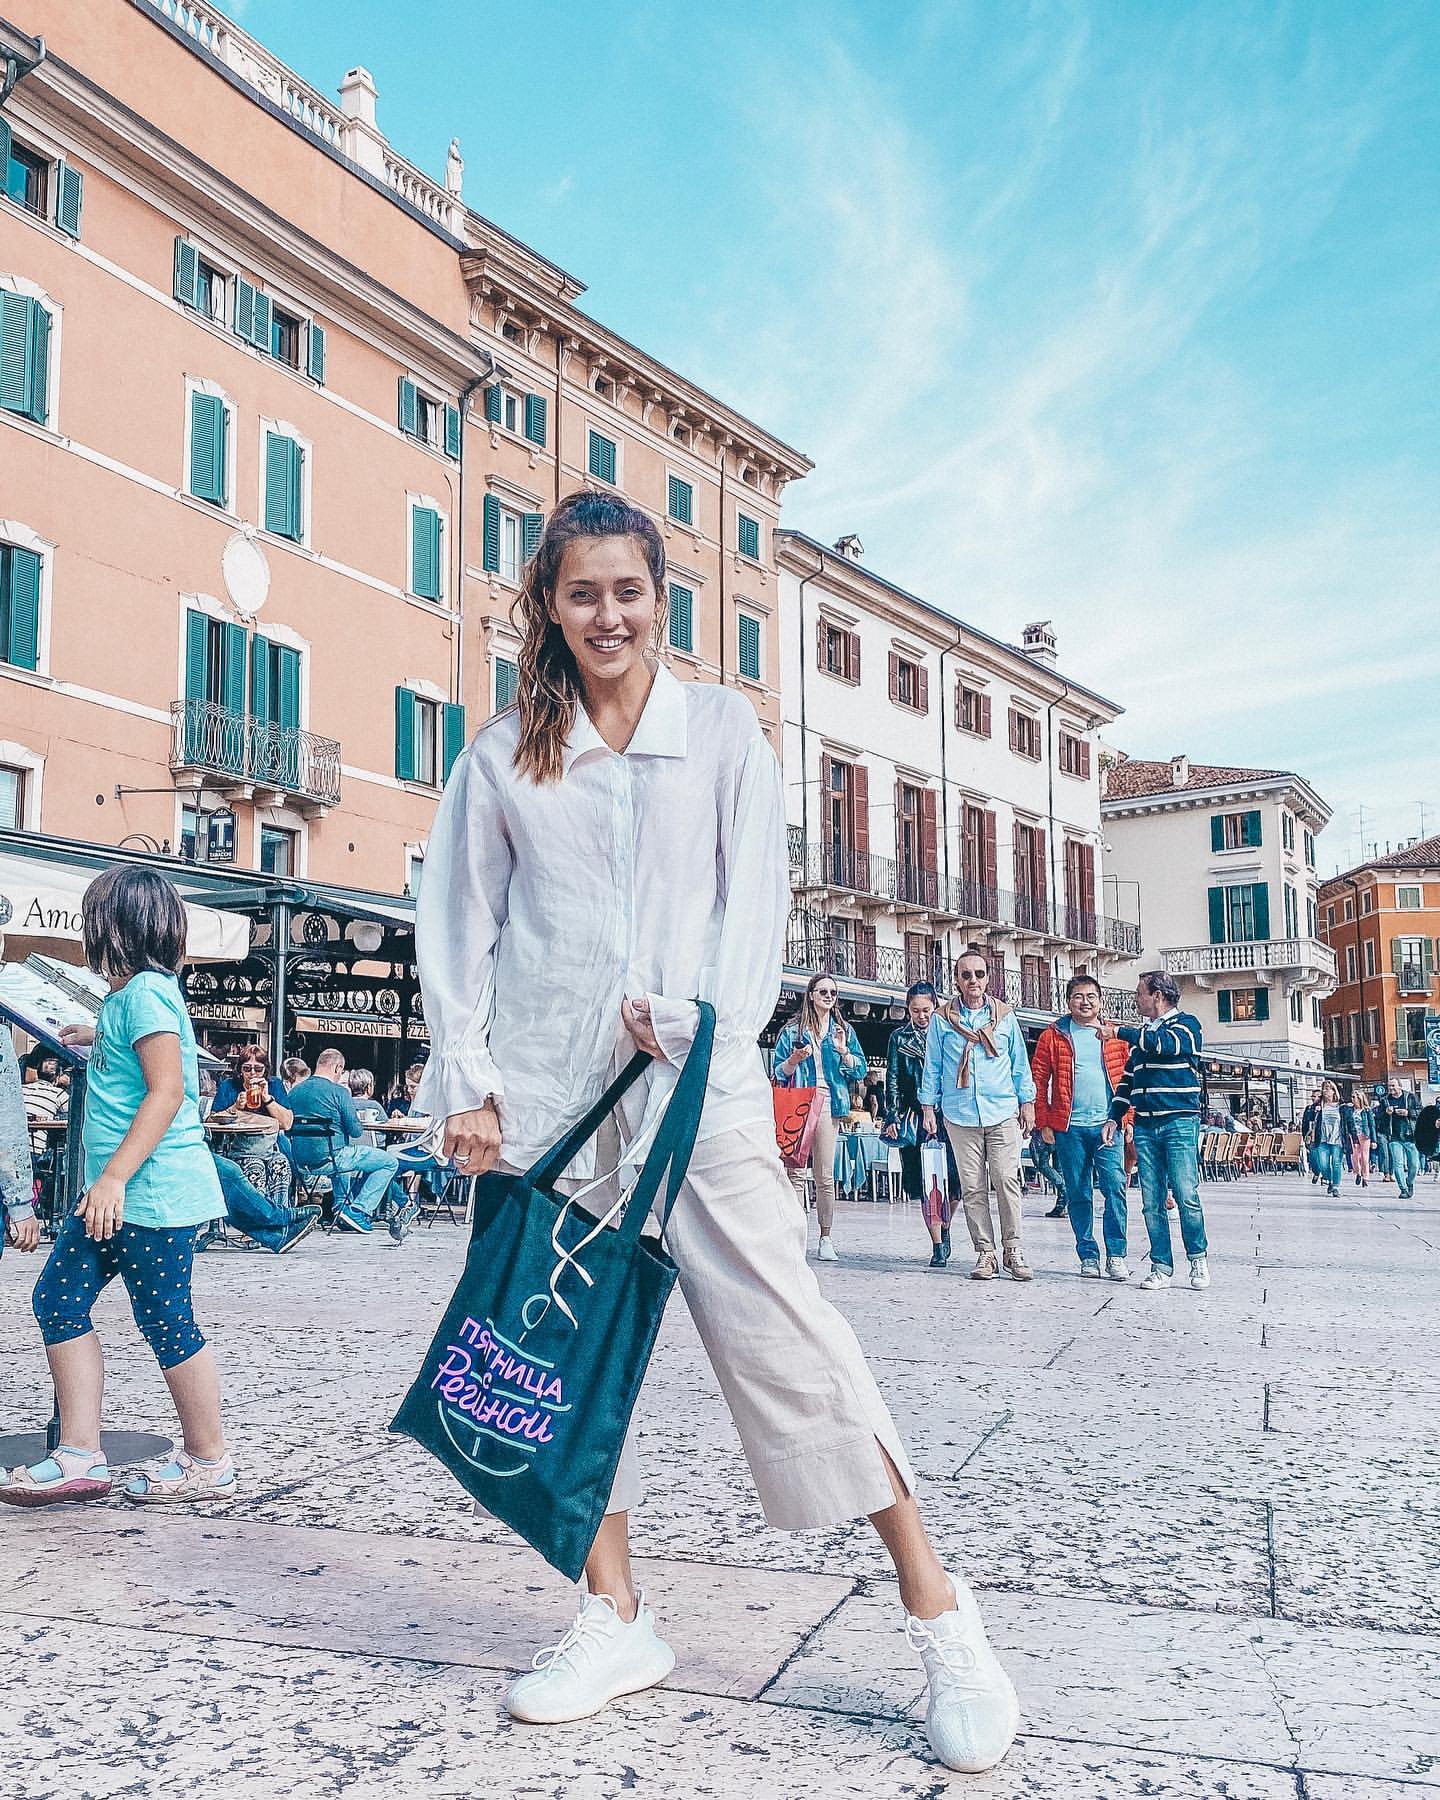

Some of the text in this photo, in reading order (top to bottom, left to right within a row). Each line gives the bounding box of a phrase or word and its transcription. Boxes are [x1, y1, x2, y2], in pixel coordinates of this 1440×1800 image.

[212, 817, 232, 847] T
[22, 897, 84, 932] Amo
[317, 1018, 431, 1038] RISTORANTE IZZE
[459, 1316, 563, 1404] ПЯТНИЦА
